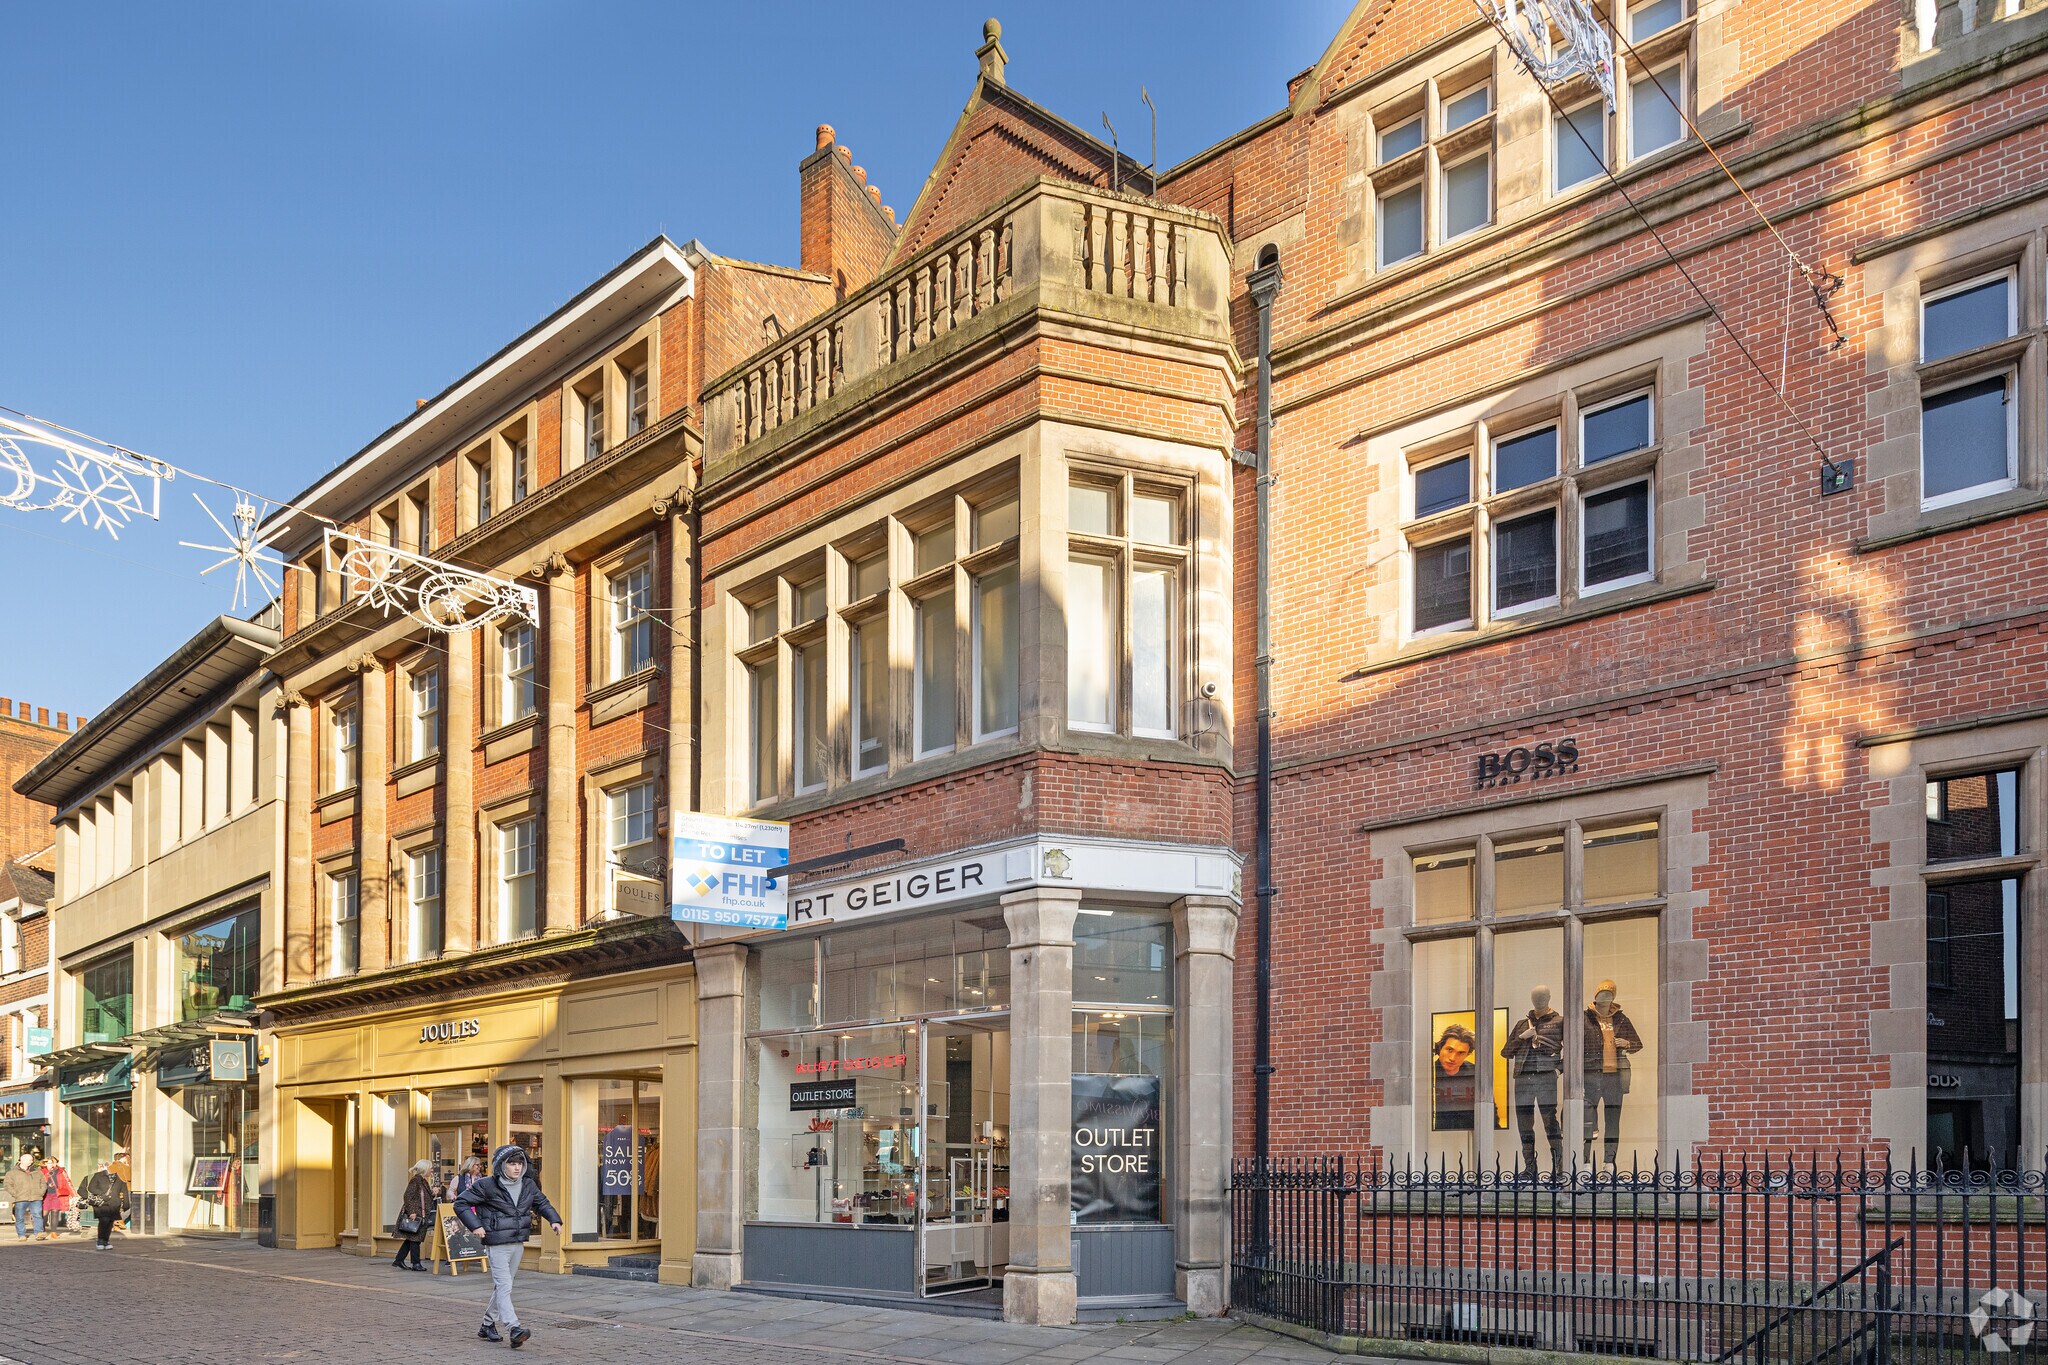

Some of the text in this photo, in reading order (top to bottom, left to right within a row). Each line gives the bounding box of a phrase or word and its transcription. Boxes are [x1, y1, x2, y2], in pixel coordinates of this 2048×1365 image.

[1478, 738, 1579, 780] BOSS
[697, 843, 766, 863] TO LET
[617, 885, 660, 902] JOULES
[722, 872, 777, 898] FHP
[787, 862, 984, 921] RT GEIGER
[721, 896, 765, 908] fhp.co.uk
[681, 908, 779, 927] 0115 950 7577
[420, 1018, 480, 1042] JOULES
[795, 1054, 906, 1074] KURT GEIGER
[792, 1088, 854, 1102] OUTLET STORE
[1075, 1128, 1154, 1147] OUTLET
[1081, 1154, 1149, 1173] STORE
